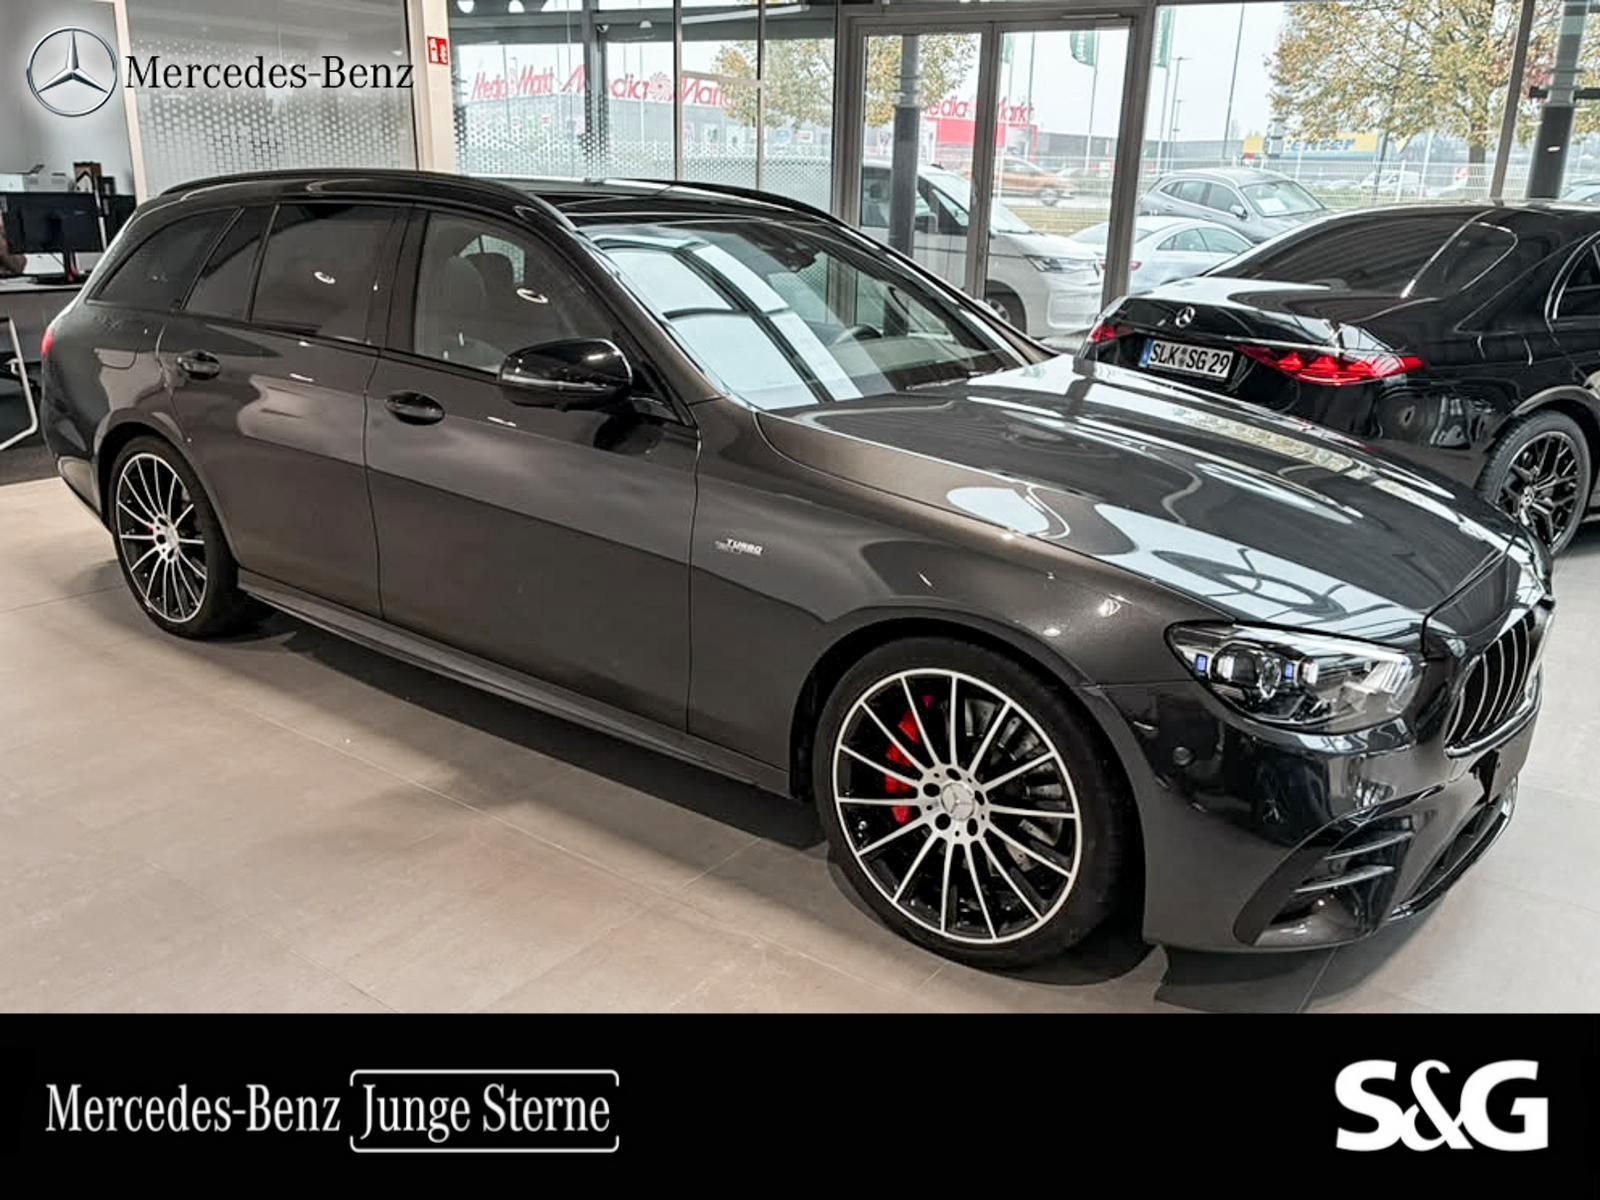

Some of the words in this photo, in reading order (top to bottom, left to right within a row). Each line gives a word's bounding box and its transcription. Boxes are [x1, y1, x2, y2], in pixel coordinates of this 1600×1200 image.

[1150, 343, 1179, 366] SLK
[1185, 349, 1208, 371] SG
[1207, 352, 1231, 375] 29
